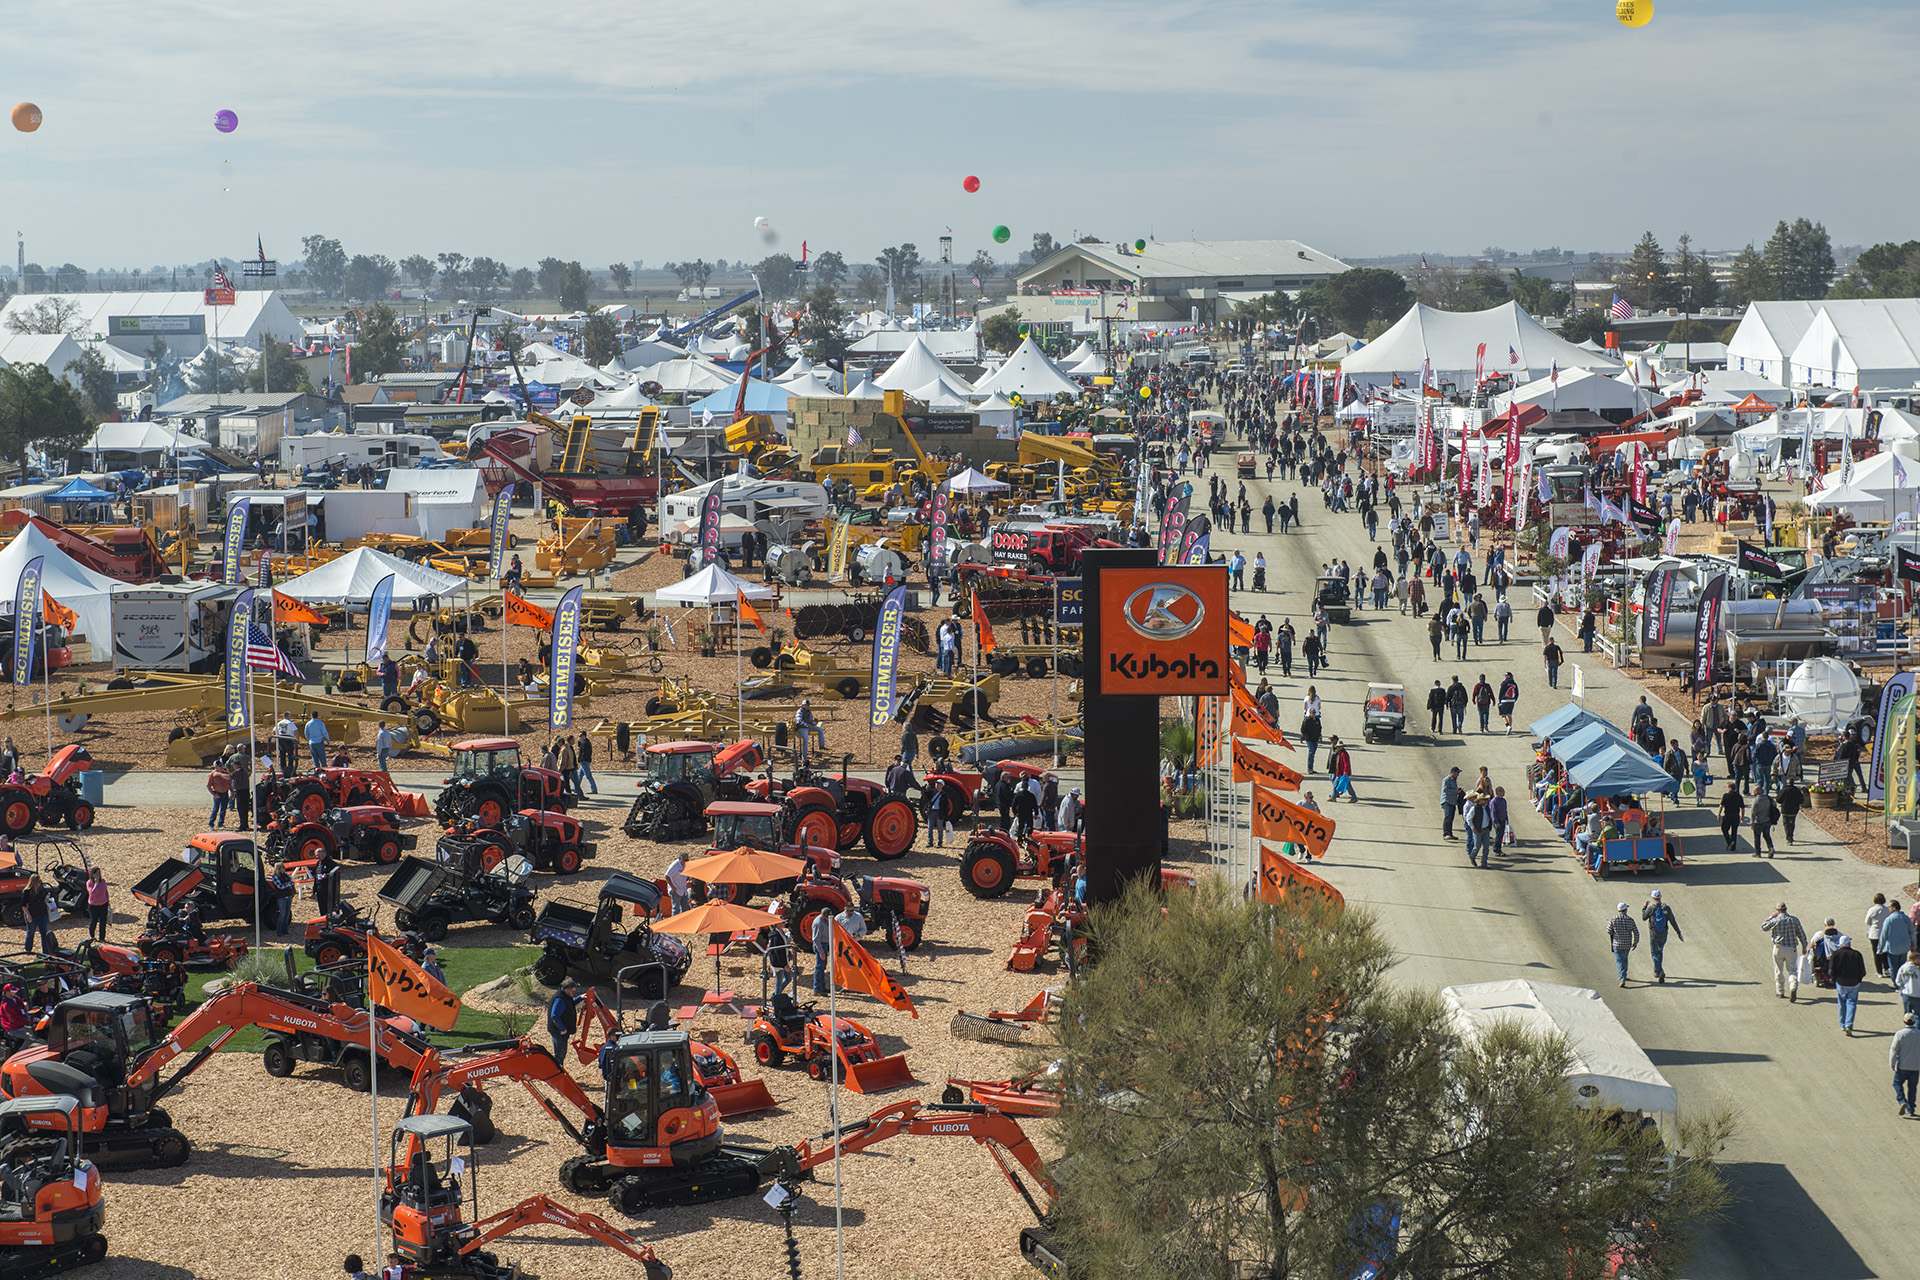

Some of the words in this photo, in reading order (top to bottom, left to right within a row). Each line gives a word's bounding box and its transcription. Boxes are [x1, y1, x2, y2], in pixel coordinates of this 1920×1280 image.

[490, 499, 510, 580] SCHMEISER
[705, 494, 721, 561] DARF
[931, 493, 948, 560] DARF
[993, 532, 1029, 551] DARF
[225, 514, 244, 584] HMEISER
[994, 551, 1007, 559] HAY
[1007, 552, 1028, 561] RAKES
[1652, 569, 1665, 603] Sales
[1650, 604, 1660, 619] W
[1700, 600, 1711, 640] Sales
[16, 576, 37, 684] SCHMEISER
[1649, 620, 1660, 640] Big
[1699, 641, 1708, 658] W
[228, 611, 247, 728] SCHMEISER
[553, 609, 575, 726] SCHMEISER
[872, 608, 898, 726] SCHMEISER
[1110, 653, 1220, 679] Kubota
[1697, 660, 1709, 681] Big
[370, 956, 455, 1010] Kubo
[283, 1015, 318, 1030] KUBOTA
[467, 1065, 501, 1080] KUBOTA
[932, 1123, 970, 1133] KUBOTA
[541, 1210, 568, 1226] KUBOTA
